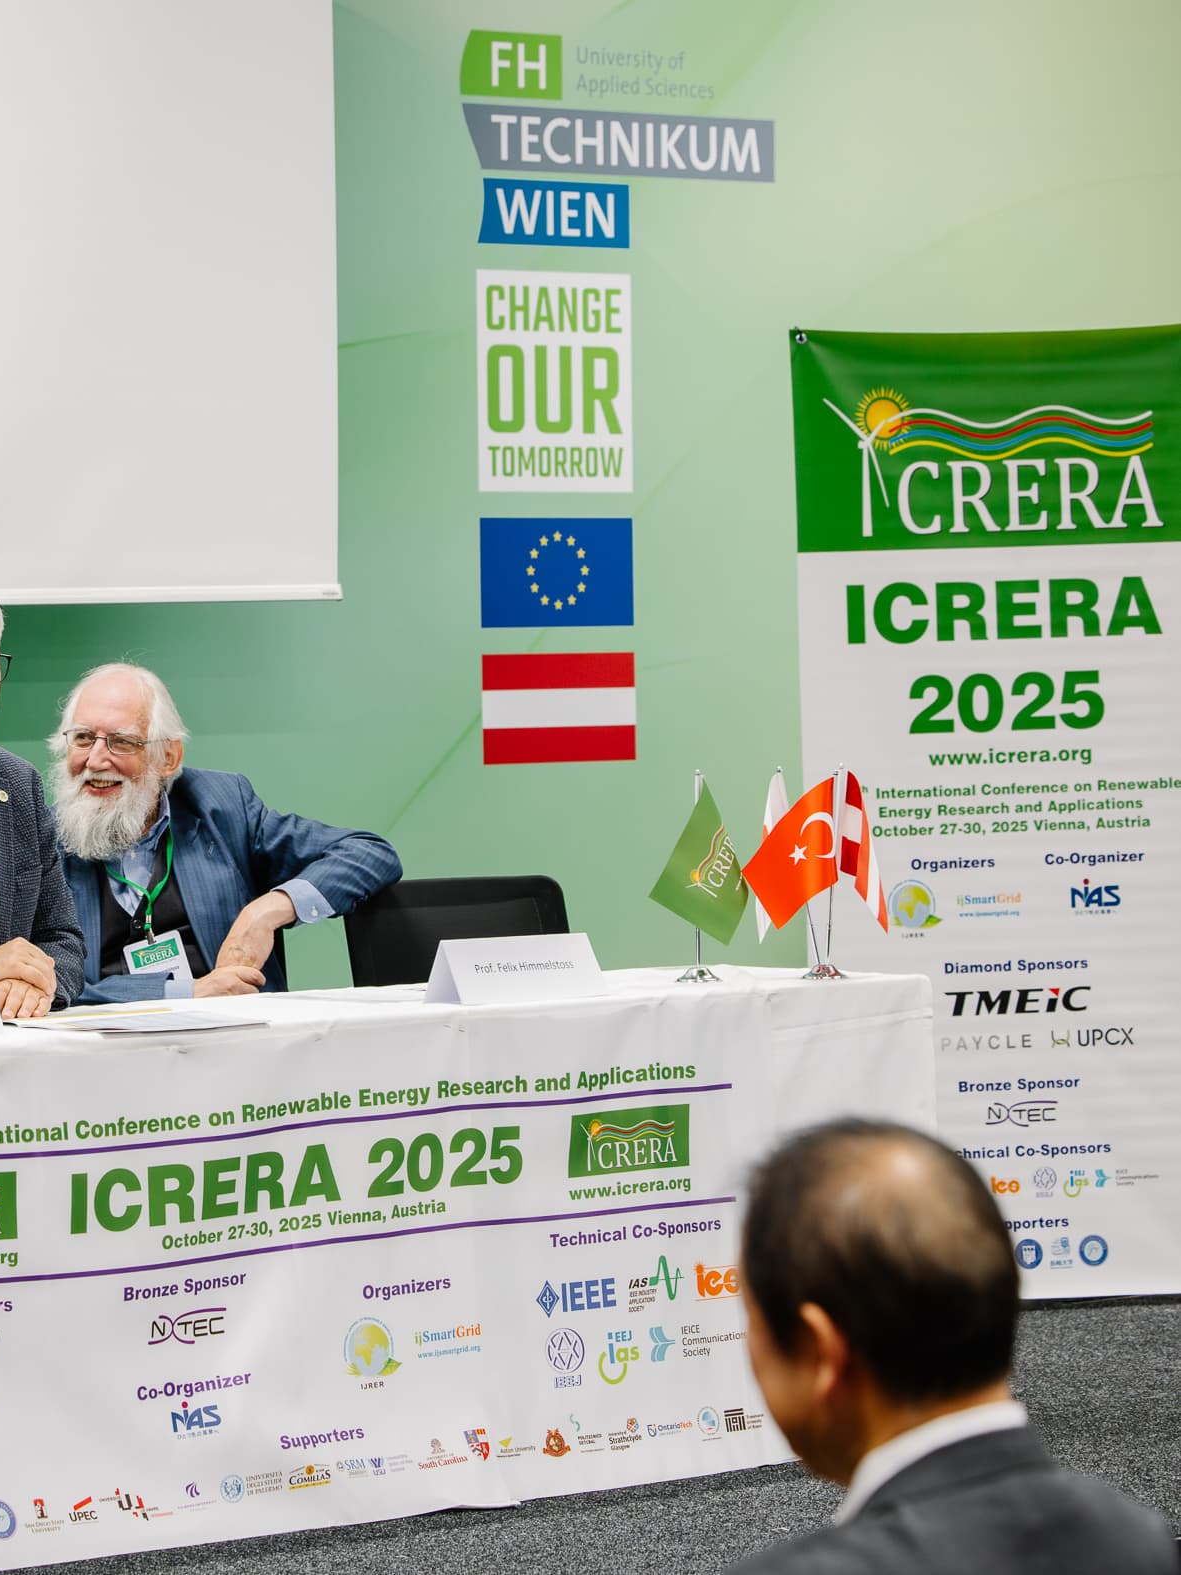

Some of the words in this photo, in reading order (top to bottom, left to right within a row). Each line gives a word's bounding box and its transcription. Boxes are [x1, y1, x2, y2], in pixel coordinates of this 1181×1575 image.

[491, 41, 546, 90] FH
[576, 46, 663, 72] University
[668, 51, 685, 70] of
[576, 74, 640, 97] Applied
[645, 77, 715, 100] Sciences
[491, 114, 761, 174] TECHNIKUM
[496, 188, 615, 239] WIEN
[486, 285, 623, 333] CHANGE
[487, 344, 623, 434] OUR
[488, 446, 623, 478] TOMORROW
[846, 576, 1163, 644] ICRERA
[909, 670, 1105, 734] 2025
[929, 748, 1093, 766] www.icrera.org
[876, 784, 976, 799] International
[981, 781, 1068, 796] Conference
[1074, 782, 1093, 792] on
[1097, 777, 1181, 791] Renewable
[879, 806, 932, 820] Energy
[938, 802, 1009, 817] Research
[1015, 801, 1042, 814] and
[1048, 797, 1143, 813] Applications
[872, 824, 934, 837] October
[940, 823, 986, 836] 27-30,
[992, 821, 1028, 833] 2025
[1034, 819, 1090, 832] Vienna,
[1096, 816, 1151, 829] Austria
[911, 856, 995, 872] Organizers
[1045, 851, 1145, 867] Co-Organizer
[475, 964, 496, 974] Prof.
[497, 962, 518, 973] Felix
[519, 959, 574, 972] Himmelstoss
[944, 961, 1012, 974] Diamond
[1017, 958, 1089, 973] Sponsors
[941, 1034, 1032, 1051] PAYCLE
[1077, 1027, 1135, 1047] UPCX
[959, 1080, 1012, 1093] Bronze
[1017, 1077, 1081, 1091] Sponsor
[75, 1113, 200, 1139] Conference
[208, 1107, 235, 1127] on
[242, 1091, 351, 1122] Renewable
[358, 1083, 431, 1109] Energy
[437, 1075, 528, 1099] Research
[535, 1073, 571, 1093] and
[577, 1063, 696, 1091] Applications
[955, 1146, 1009, 1159] chnical
[1015, 1142, 1112, 1158] Co-Sponsors
[70, 1143, 342, 1235] ICRERA
[367, 1126, 523, 1198] 2025
[569, 1176, 691, 1200] www.icrera.org
[162, 1230, 222, 1252] October
[227, 1221, 273, 1242] 27-30,
[279, 1214, 322, 1234] 2025
[328, 1206, 387, 1226] Vienna,
[391, 1199, 447, 1218] Austria
[550, 1226, 627, 1248] Technical
[632, 1218, 722, 1239] Co-Sponsors
[1003, 1216, 1069, 1232] pporters
[123, 1285, 179, 1301] Bronze
[184, 1272, 246, 1295] Sponsor
[363, 1277, 451, 1301] Organizers
[628, 1277, 648, 1289] IAS
[561, 1278, 617, 1313] IEEE
[414, 1323, 481, 1346] ijSmartGrid
[681, 1324, 700, 1335] IEICE
[683, 1347, 711, 1358] Society
[137, 1372, 251, 1401] Co-Organizer
[360, 1381, 385, 1390] IJRER
[280, 1426, 364, 1450] Supporters
[609, 1434, 642, 1444] Strathclyde
[345, 1458, 366, 1470] SRM
[419, 1459, 438, 1470] South
[439, 1455, 468, 1467] Carolina
[69, 1511, 98, 1522] UPEC
